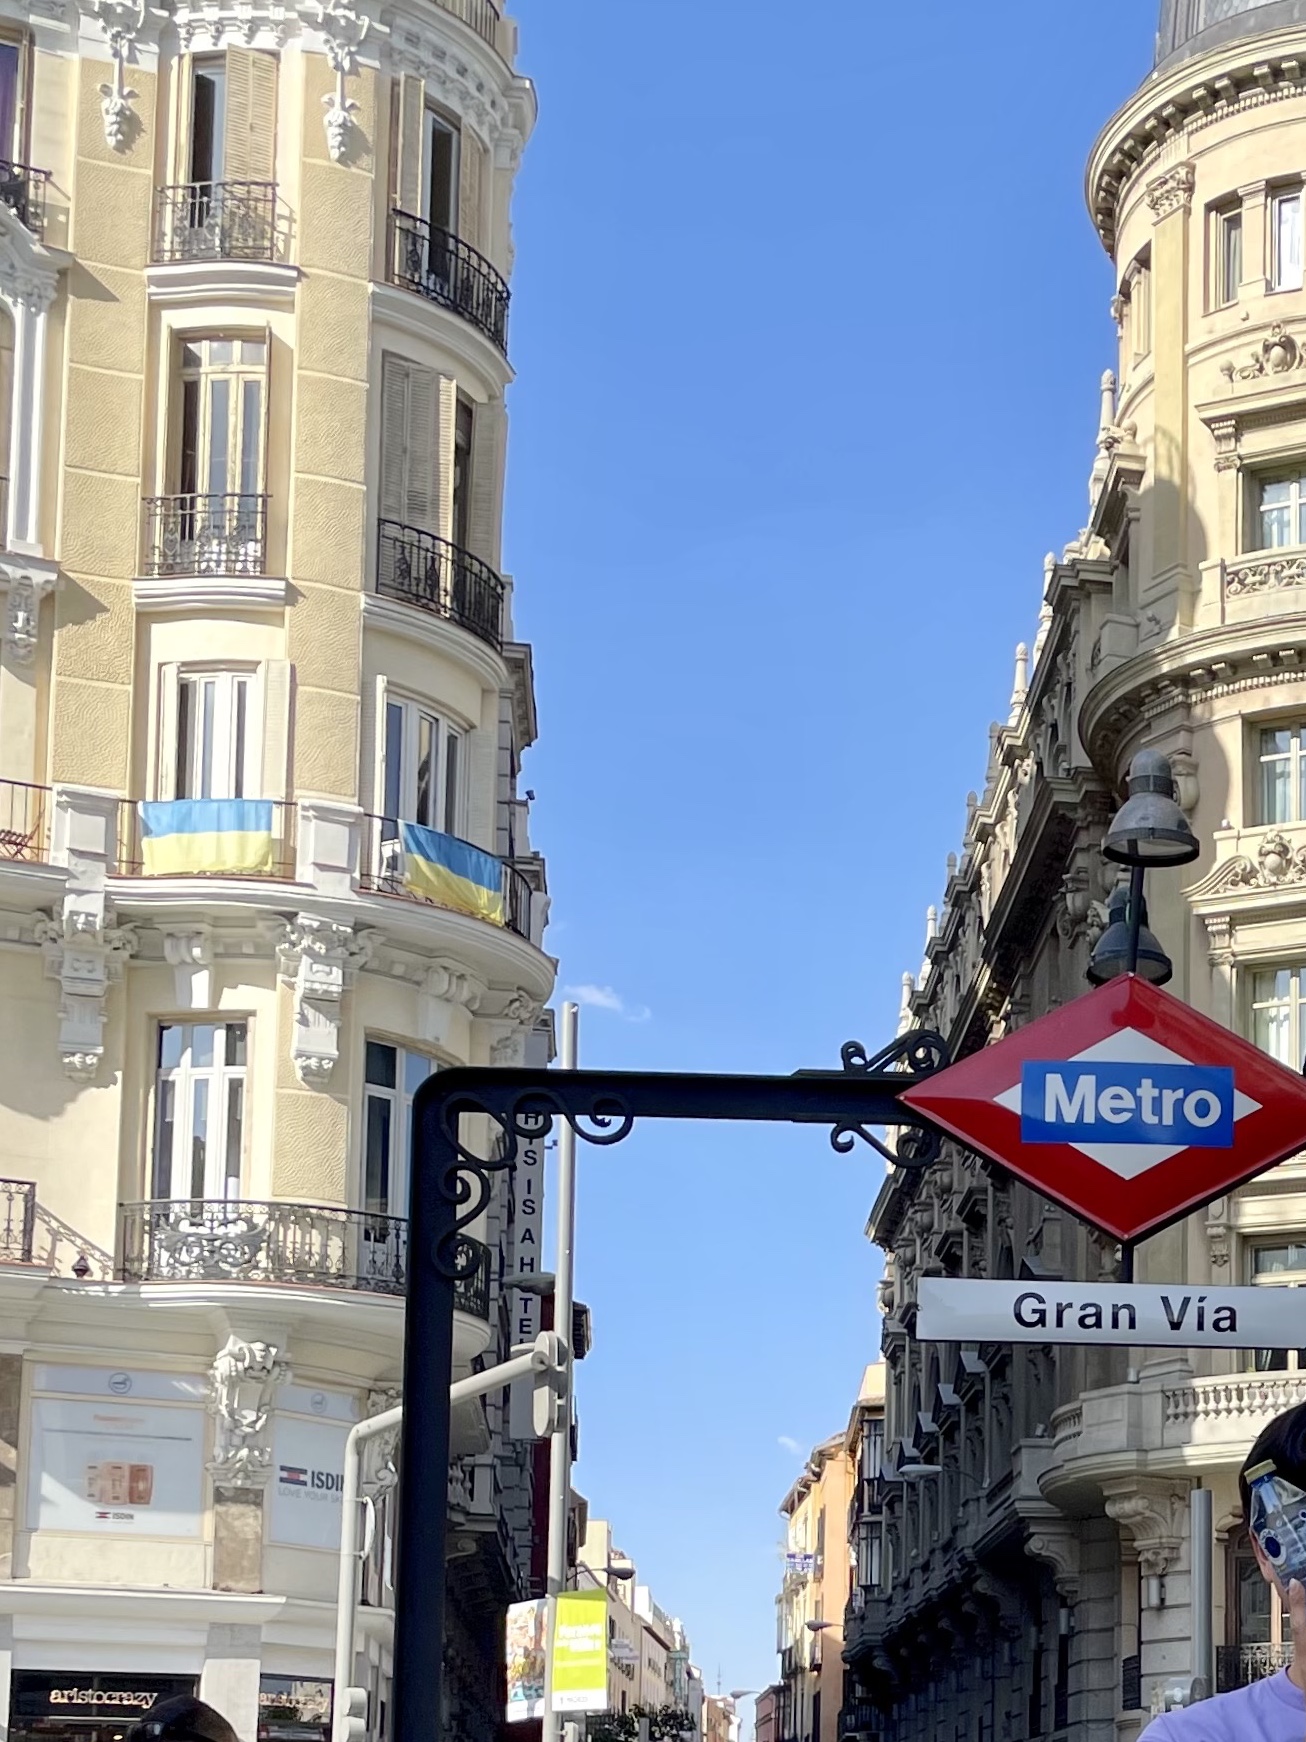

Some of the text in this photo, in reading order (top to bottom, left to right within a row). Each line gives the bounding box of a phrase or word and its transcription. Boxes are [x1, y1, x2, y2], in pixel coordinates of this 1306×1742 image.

[1044, 1073, 1222, 1128] Metro
[1013, 1292, 1238, 1333] Gran Vía
[50, 1688, 157, 1708] aristocrazy
